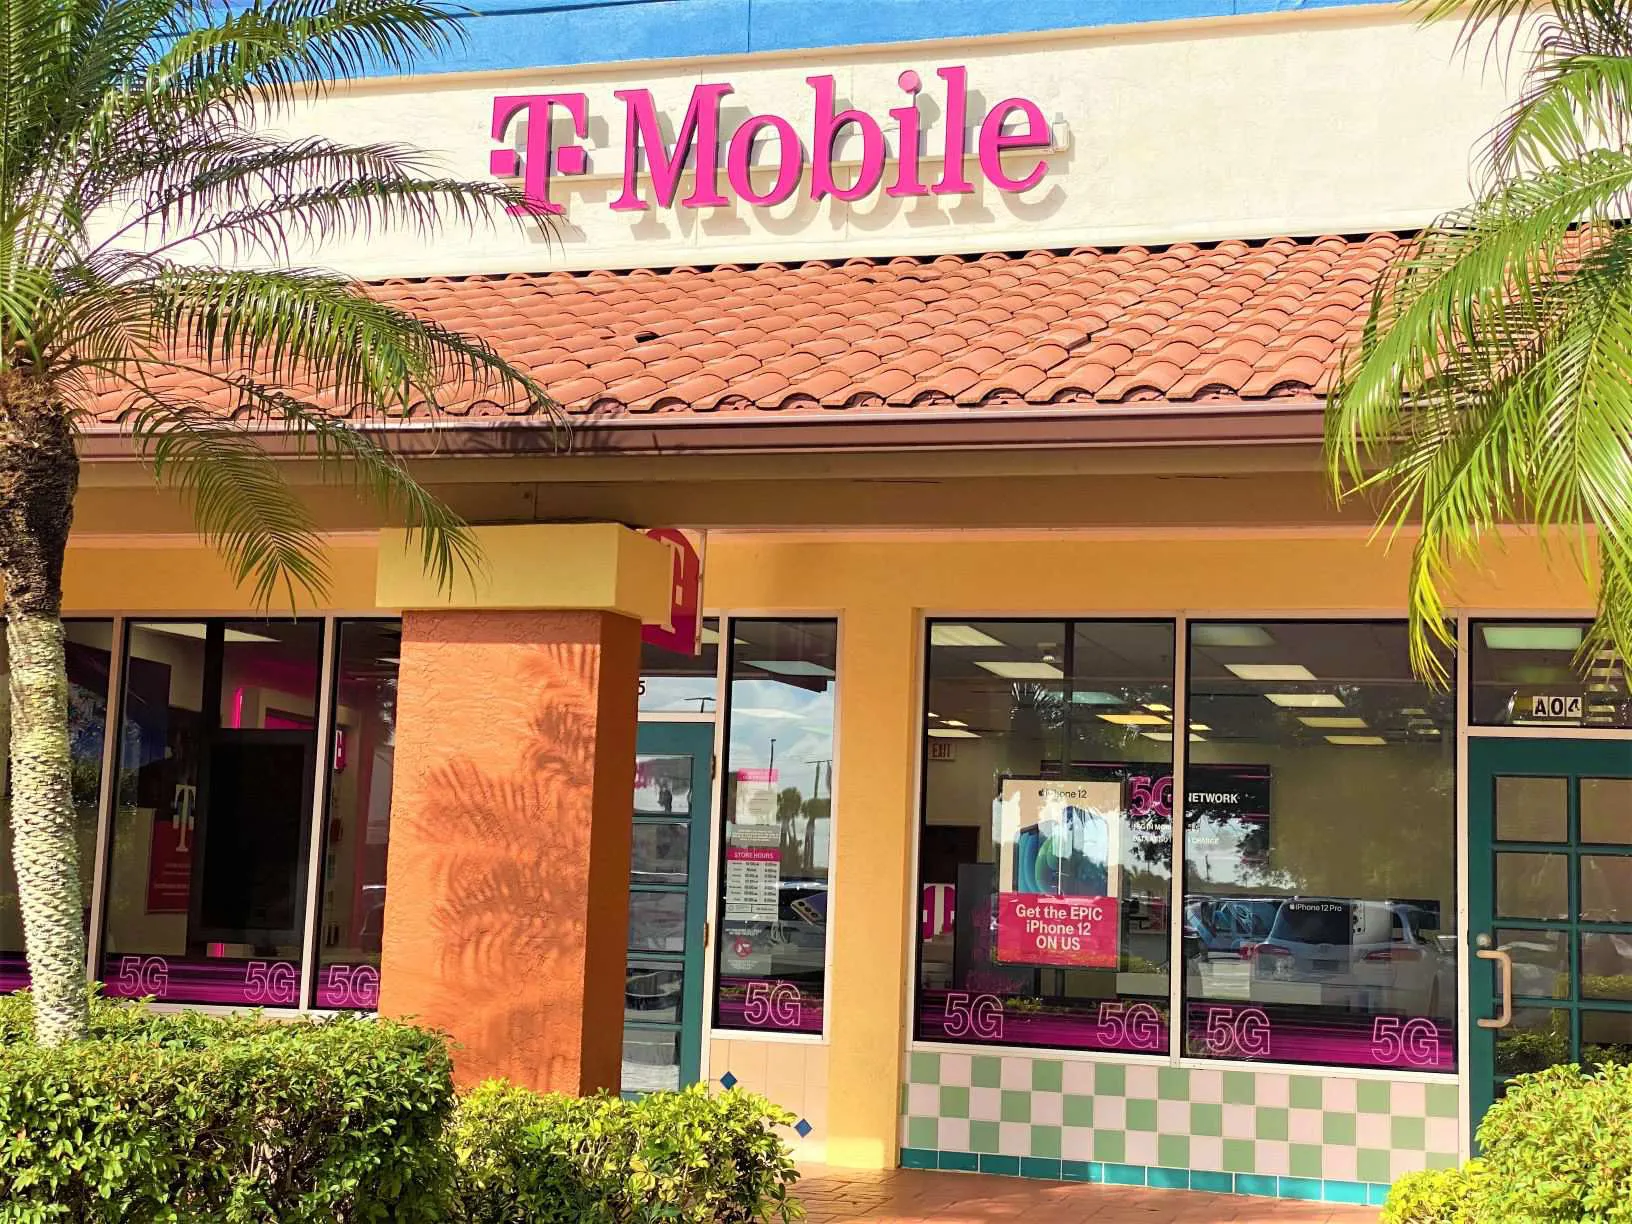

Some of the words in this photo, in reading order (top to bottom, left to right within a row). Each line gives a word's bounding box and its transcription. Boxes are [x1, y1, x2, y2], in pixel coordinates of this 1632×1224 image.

[490, 93, 588, 215] T
[611, 66, 1050, 212] Mobile
[932, 743, 951, 758] EXIT
[1078, 790, 1087, 799] 12
[1016, 904, 1041, 919] Get
[1044, 904, 1067, 919] the
[1070, 906, 1103, 921] EPIC
[1026, 920, 1075, 936] iPhone
[1077, 922, 1091, 936] 12
[1295, 903, 1320, 911] iPhone
[1321, 904, 1329, 912] 12
[1329, 904, 1342, 912] Pro
[1036, 935, 1057, 950] ON
[1061, 936, 1080, 950] US
[119, 956, 168, 997] 5G
[244, 961, 296, 1003] 5G
[327, 965, 379, 1006] 5G
[744, 982, 801, 1026] 5G
[943, 993, 1004, 1039] 5G
[1096, 1002, 1160, 1049] 5G
[1206, 1007, 1271, 1055] 5G
[1370, 1016, 1439, 1065] 5G
